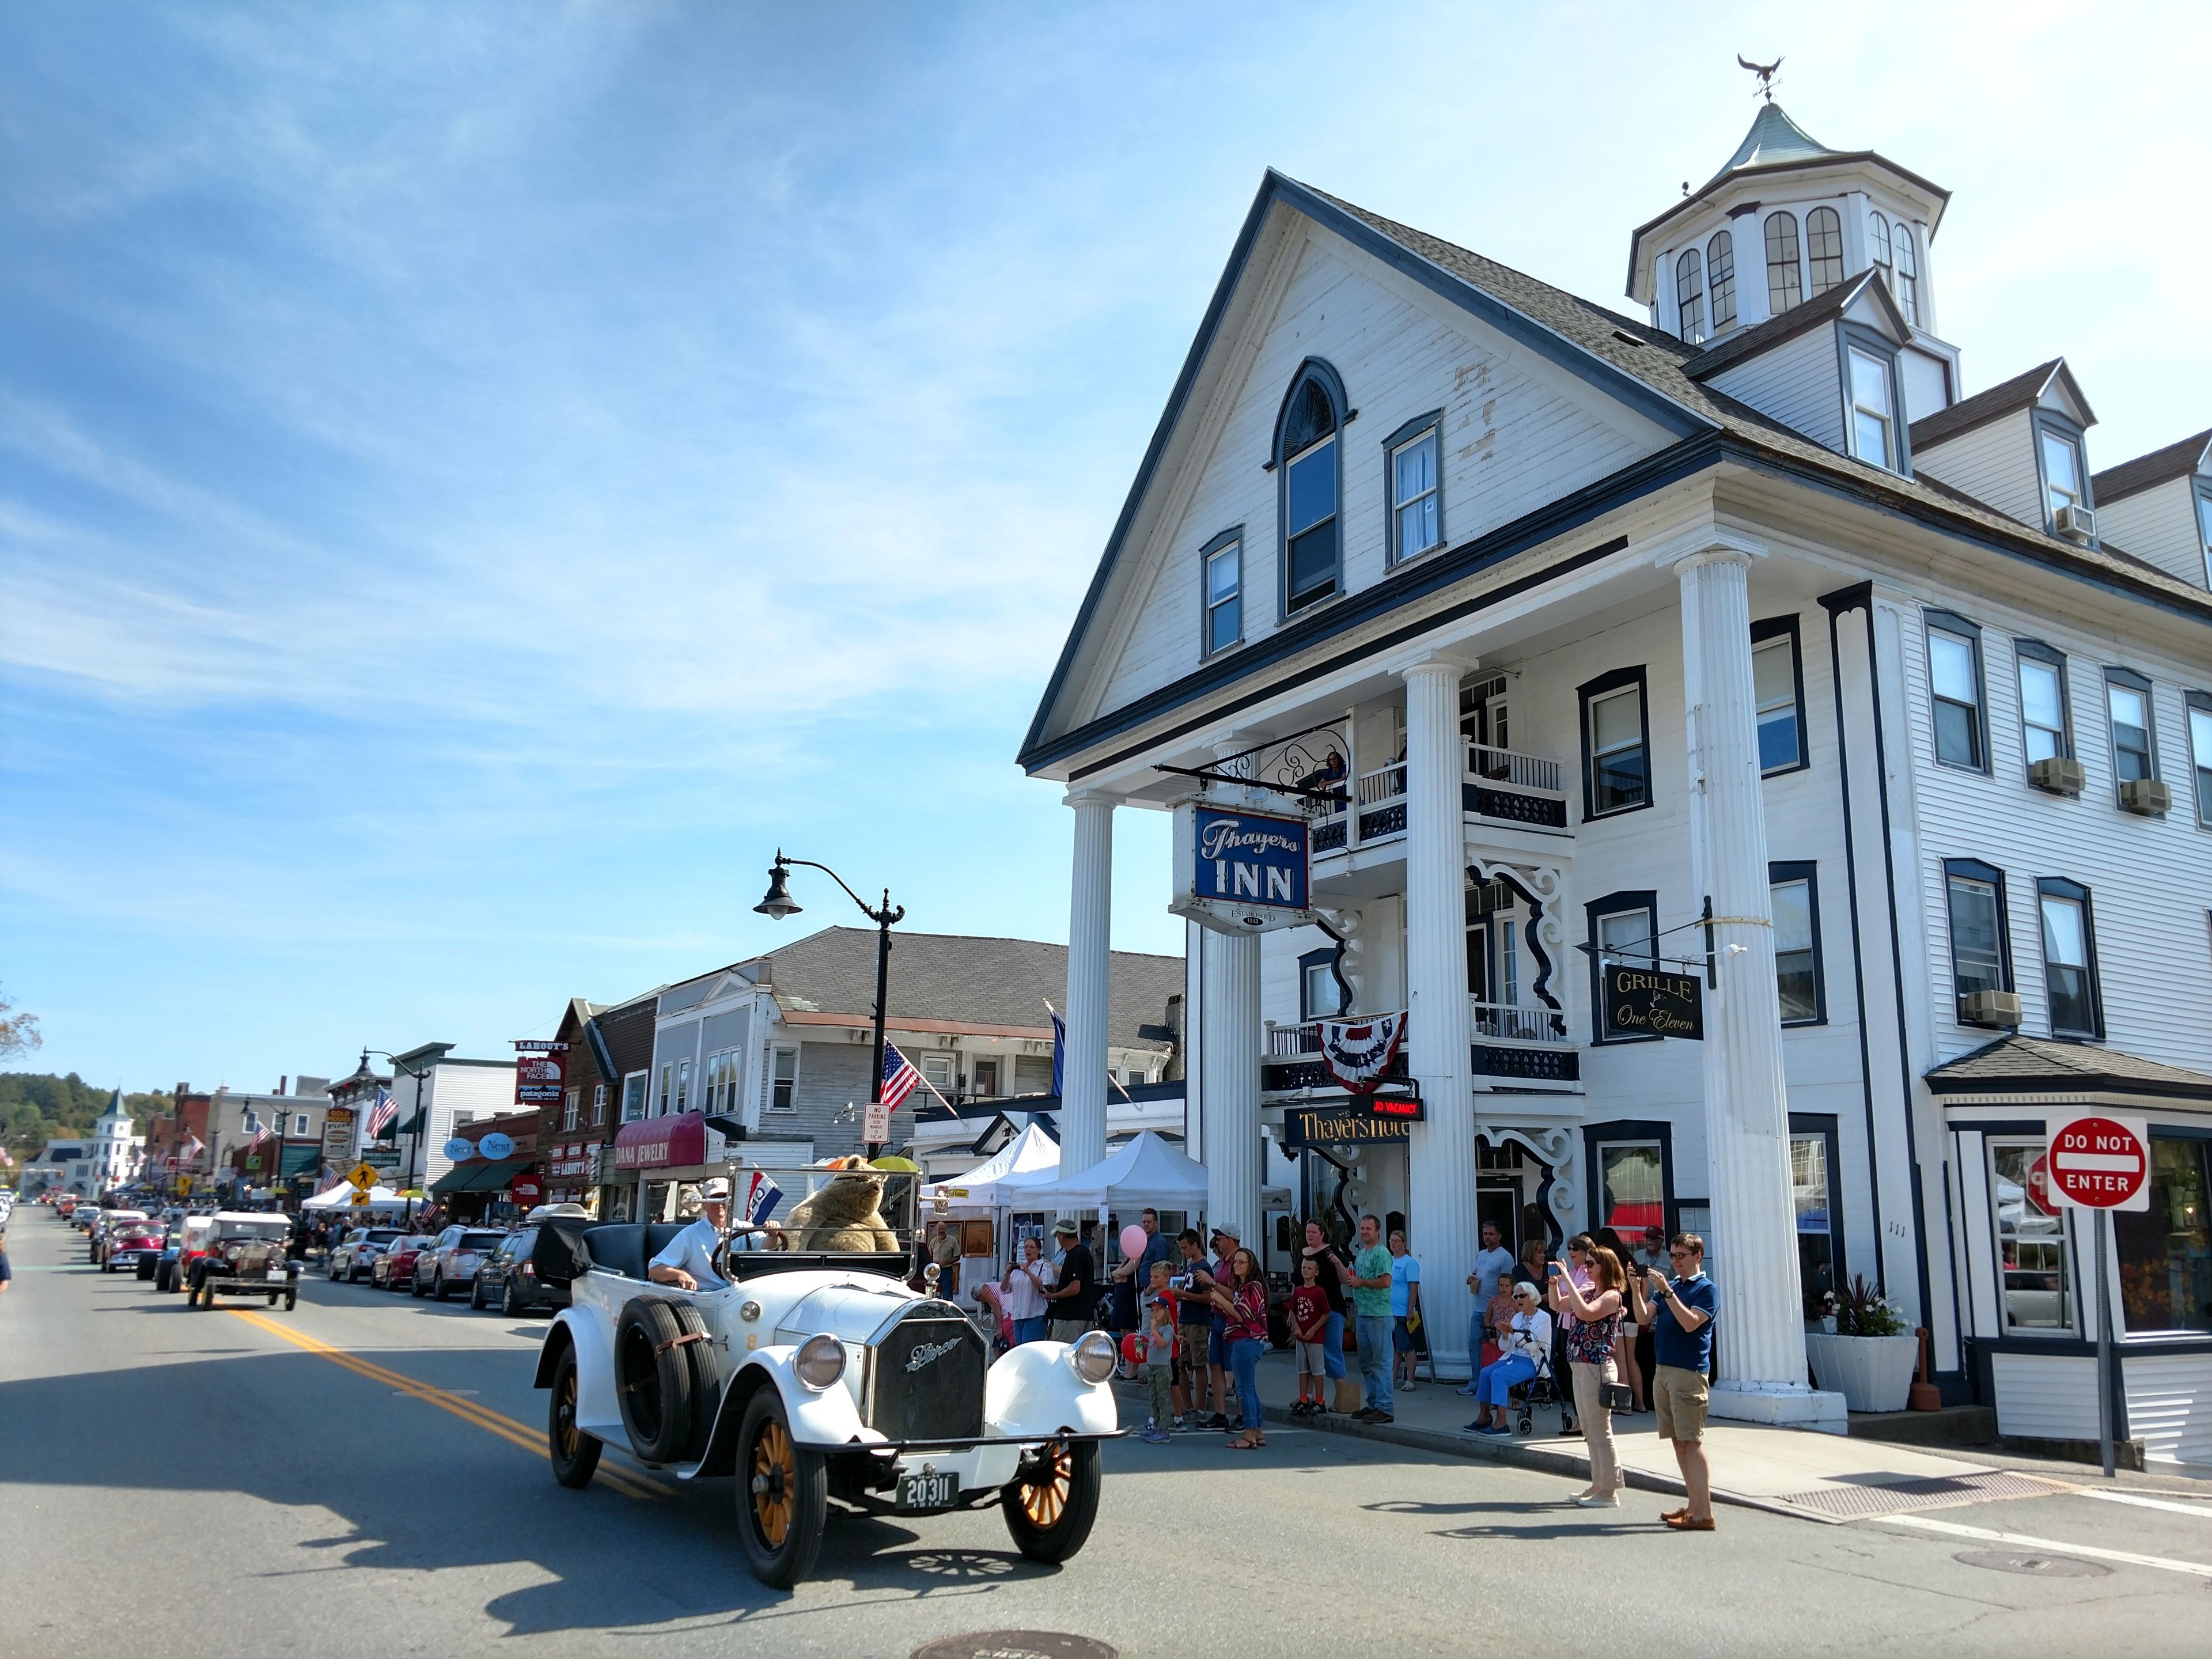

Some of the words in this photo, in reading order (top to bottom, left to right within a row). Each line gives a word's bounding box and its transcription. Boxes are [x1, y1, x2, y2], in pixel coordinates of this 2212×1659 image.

[1201, 819, 1300, 859] Thayers
[1215, 859, 1294, 902] INN
[1231, 910, 1275, 922] ESTABLISHED
[1616, 972, 1692, 1003] GRILLE
[1617, 1005, 1646, 1025] One
[1649, 1009, 1695, 1031] Eleven
[519, 1041, 569, 1050] LAHOUT'S
[1370, 1119, 1410, 1138] Hote
[450, 1144, 471, 1153] Nest
[487, 1140, 511, 1151] Nest
[2064, 1134, 2088, 1149] DO
[2096, 1136, 2132, 1151] NOT
[616, 1146, 635, 1164] DANA
[637, 1142, 669, 1167] JEWELRY
[2066, 1174, 2128, 1192] ENTER
[1889, 1221, 1906, 1238] 111
[907, 1478, 949, 1504] 20311
